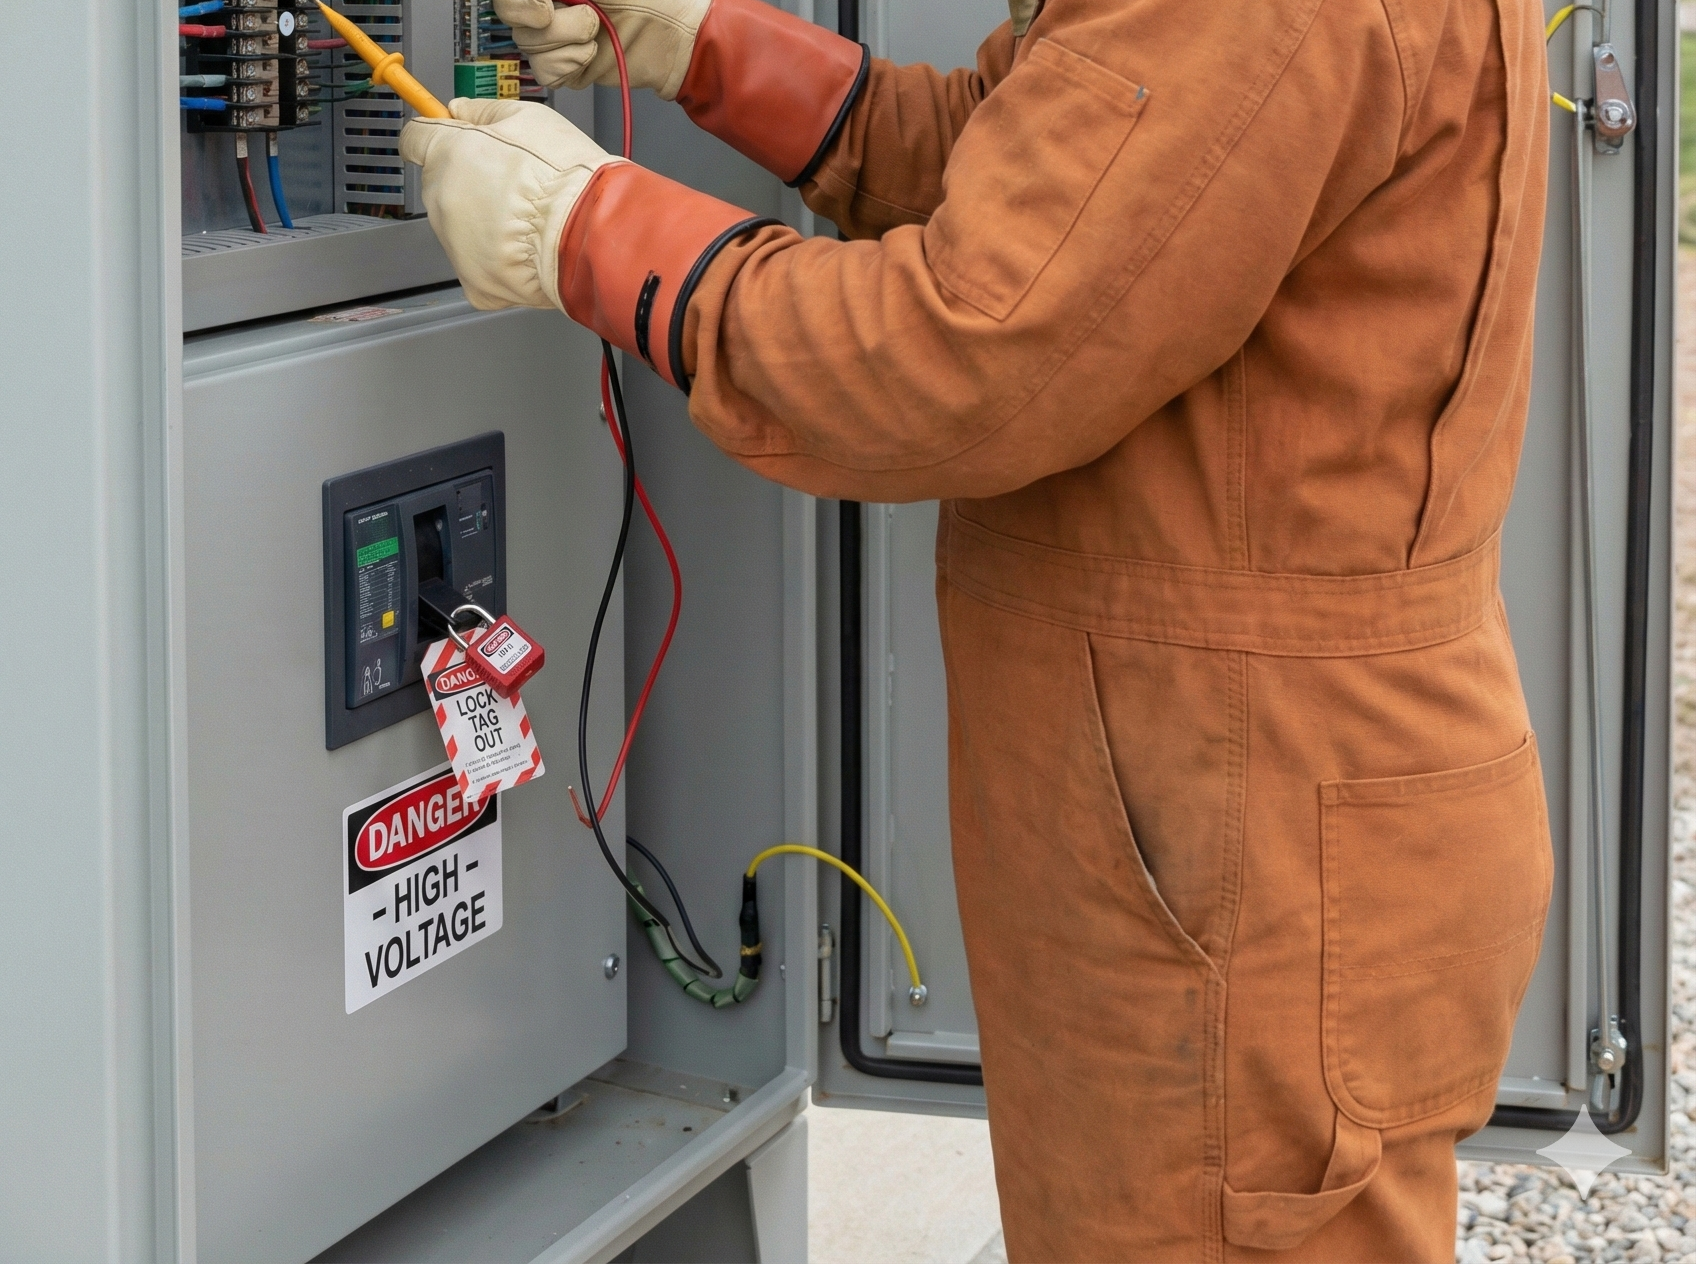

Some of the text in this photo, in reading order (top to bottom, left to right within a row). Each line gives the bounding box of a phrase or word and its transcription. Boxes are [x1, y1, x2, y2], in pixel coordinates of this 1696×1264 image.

[456, 687, 499, 717] LOCK
[468, 708, 500, 734] TAG
[474, 727, 505, 753] OUT
[364, 889, 487, 989] VOLTAGE
